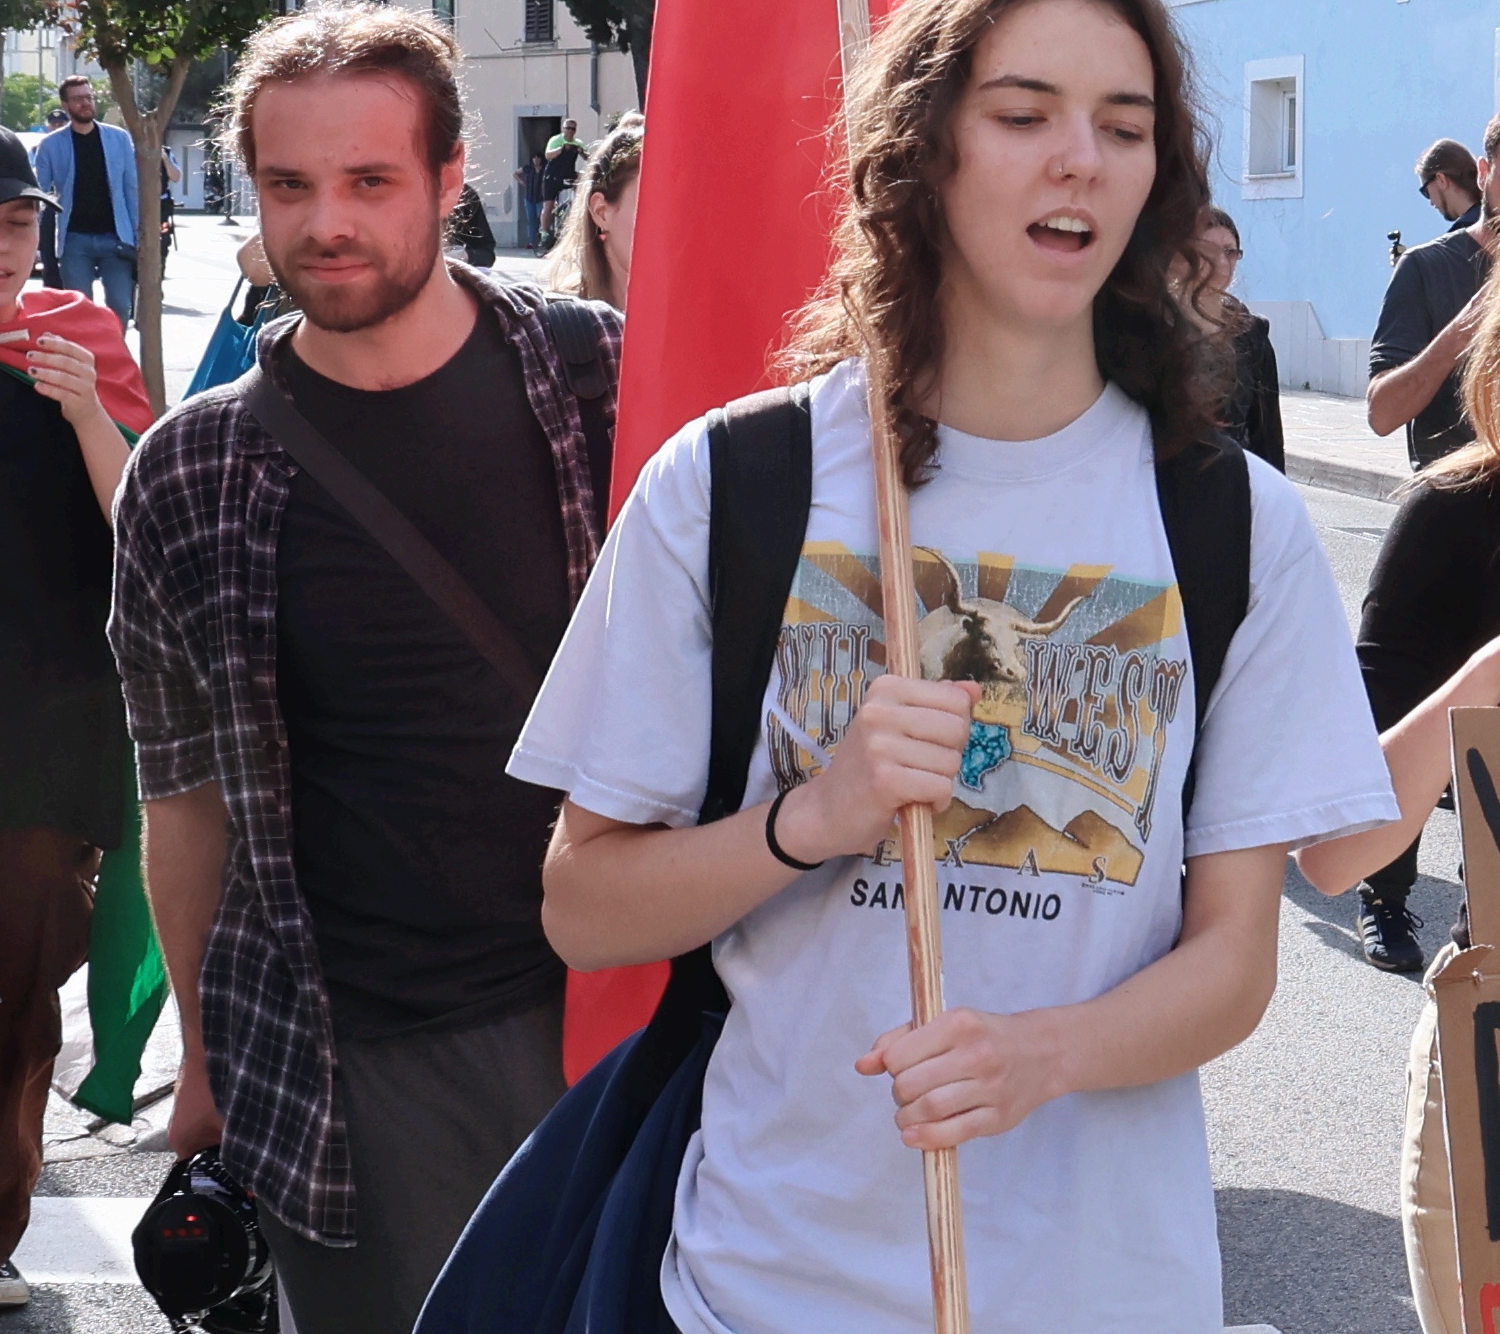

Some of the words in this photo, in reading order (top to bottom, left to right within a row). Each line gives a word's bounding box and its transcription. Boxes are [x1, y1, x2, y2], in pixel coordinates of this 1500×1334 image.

[1021, 638, 1188, 844] WEST
[873, 838, 1107, 885] EXAS
[936, 881, 1062, 921] NTONIO
